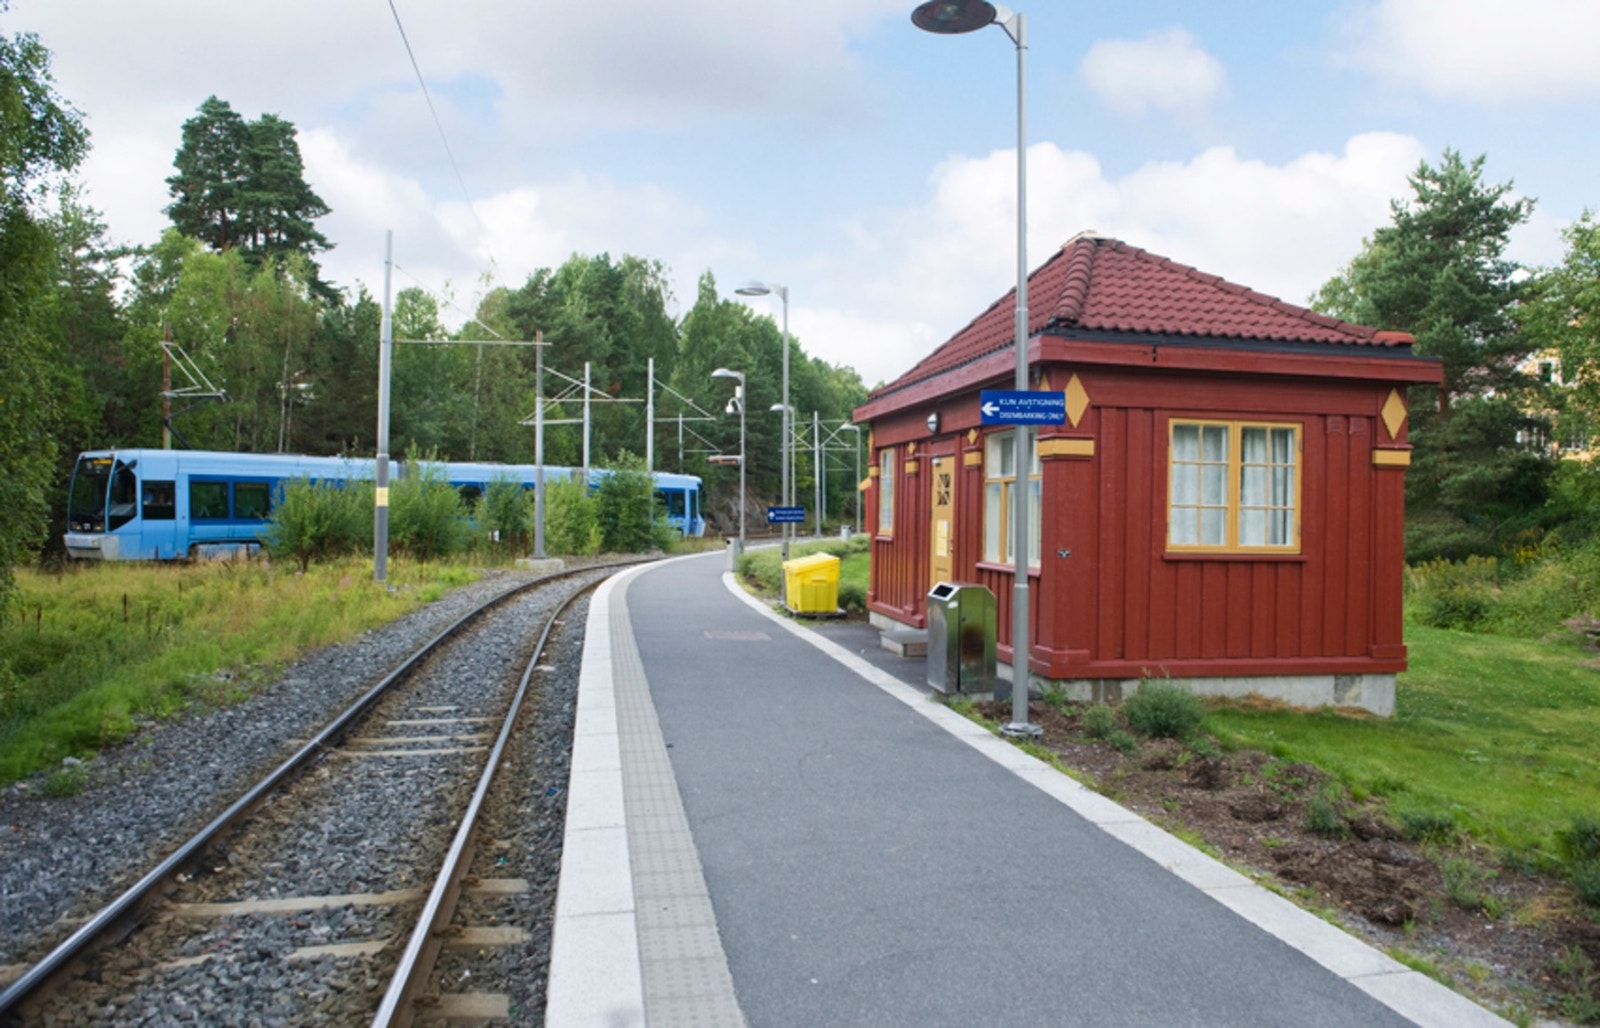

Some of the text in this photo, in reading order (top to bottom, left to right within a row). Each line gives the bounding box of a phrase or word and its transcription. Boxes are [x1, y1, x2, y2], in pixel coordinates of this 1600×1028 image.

[999, 398, 1065, 407] KUN AVSTIGNING
[999, 411, 1046, 419] DISEMBARKING
